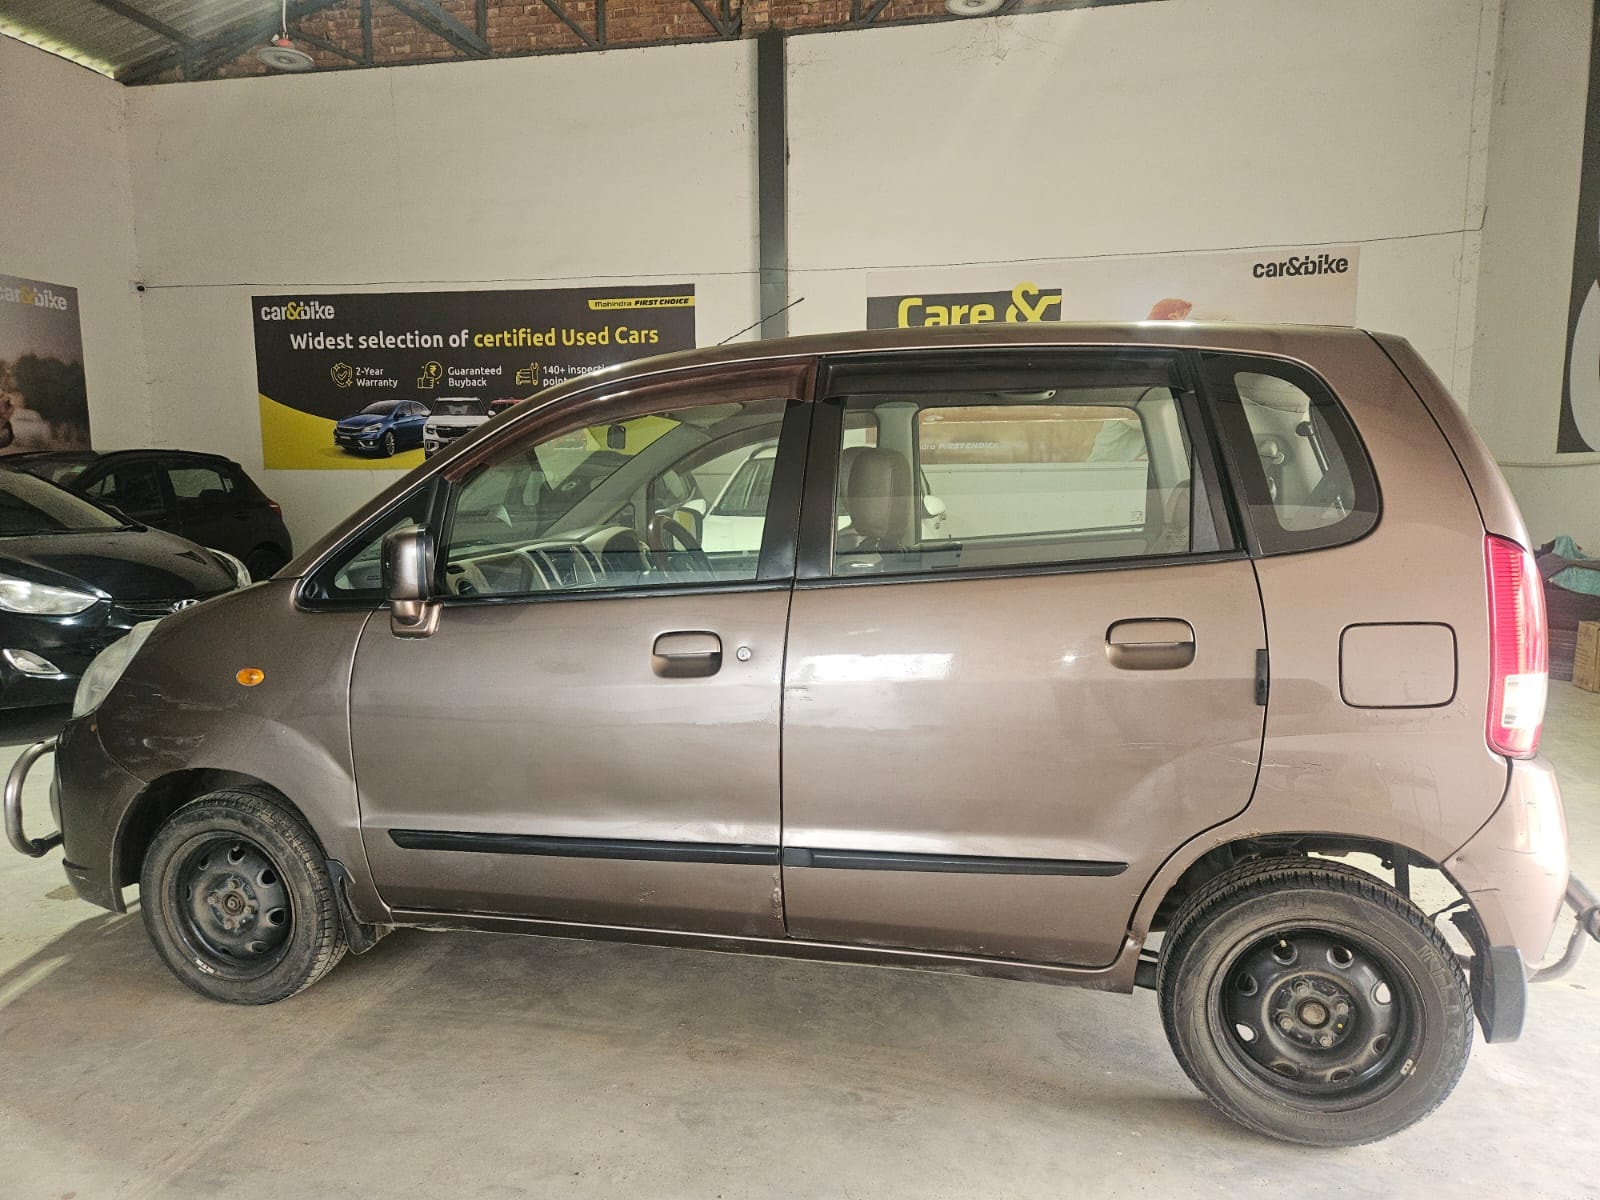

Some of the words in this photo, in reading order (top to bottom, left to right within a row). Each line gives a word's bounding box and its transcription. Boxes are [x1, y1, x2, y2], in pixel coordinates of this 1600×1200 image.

[1253, 254, 1349, 278] car&bike
[594, 300, 632, 308] Mahindra
[261, 301, 336, 321] car&bike
[898, 297, 995, 328] Care
[290, 332, 354, 350] Widest
[358, 330, 444, 349] selection
[448, 329, 469, 348] of
[473, 327, 556, 348] certified
[561, 327, 609, 347] Used
[614, 326, 659, 344] Cars
[355, 367, 384, 376] 2-Year
[448, 365, 502, 376] Guaranteed
[542, 365, 566, 375] 140+
[356, 378, 398, 388] Warranty
[448, 377, 488, 387] Buyback
